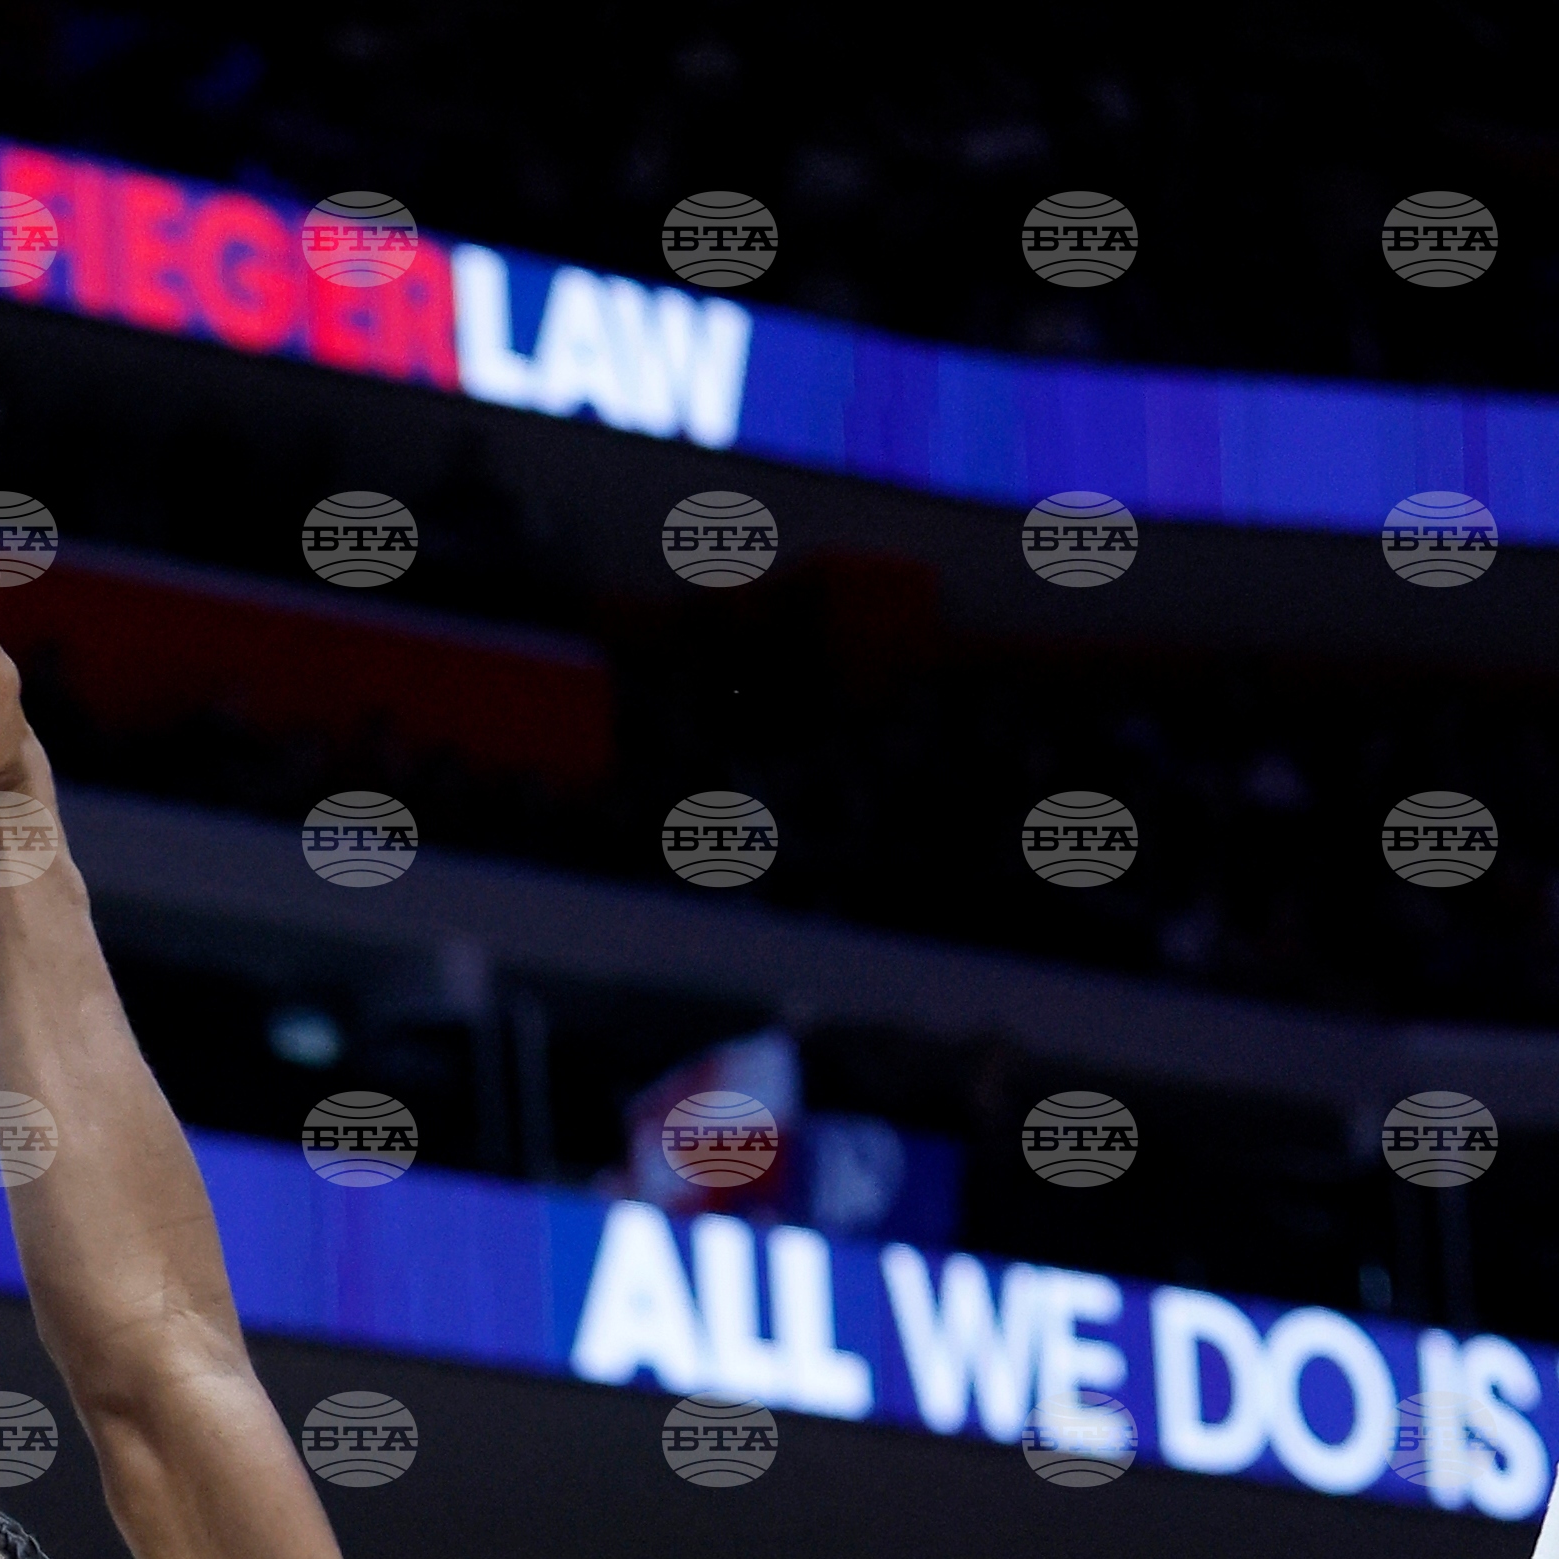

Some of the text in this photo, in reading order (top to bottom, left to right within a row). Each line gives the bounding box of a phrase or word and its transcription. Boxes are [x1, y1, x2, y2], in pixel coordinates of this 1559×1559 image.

[572, 1199, 1551, 1523] ALL WE DO IS
